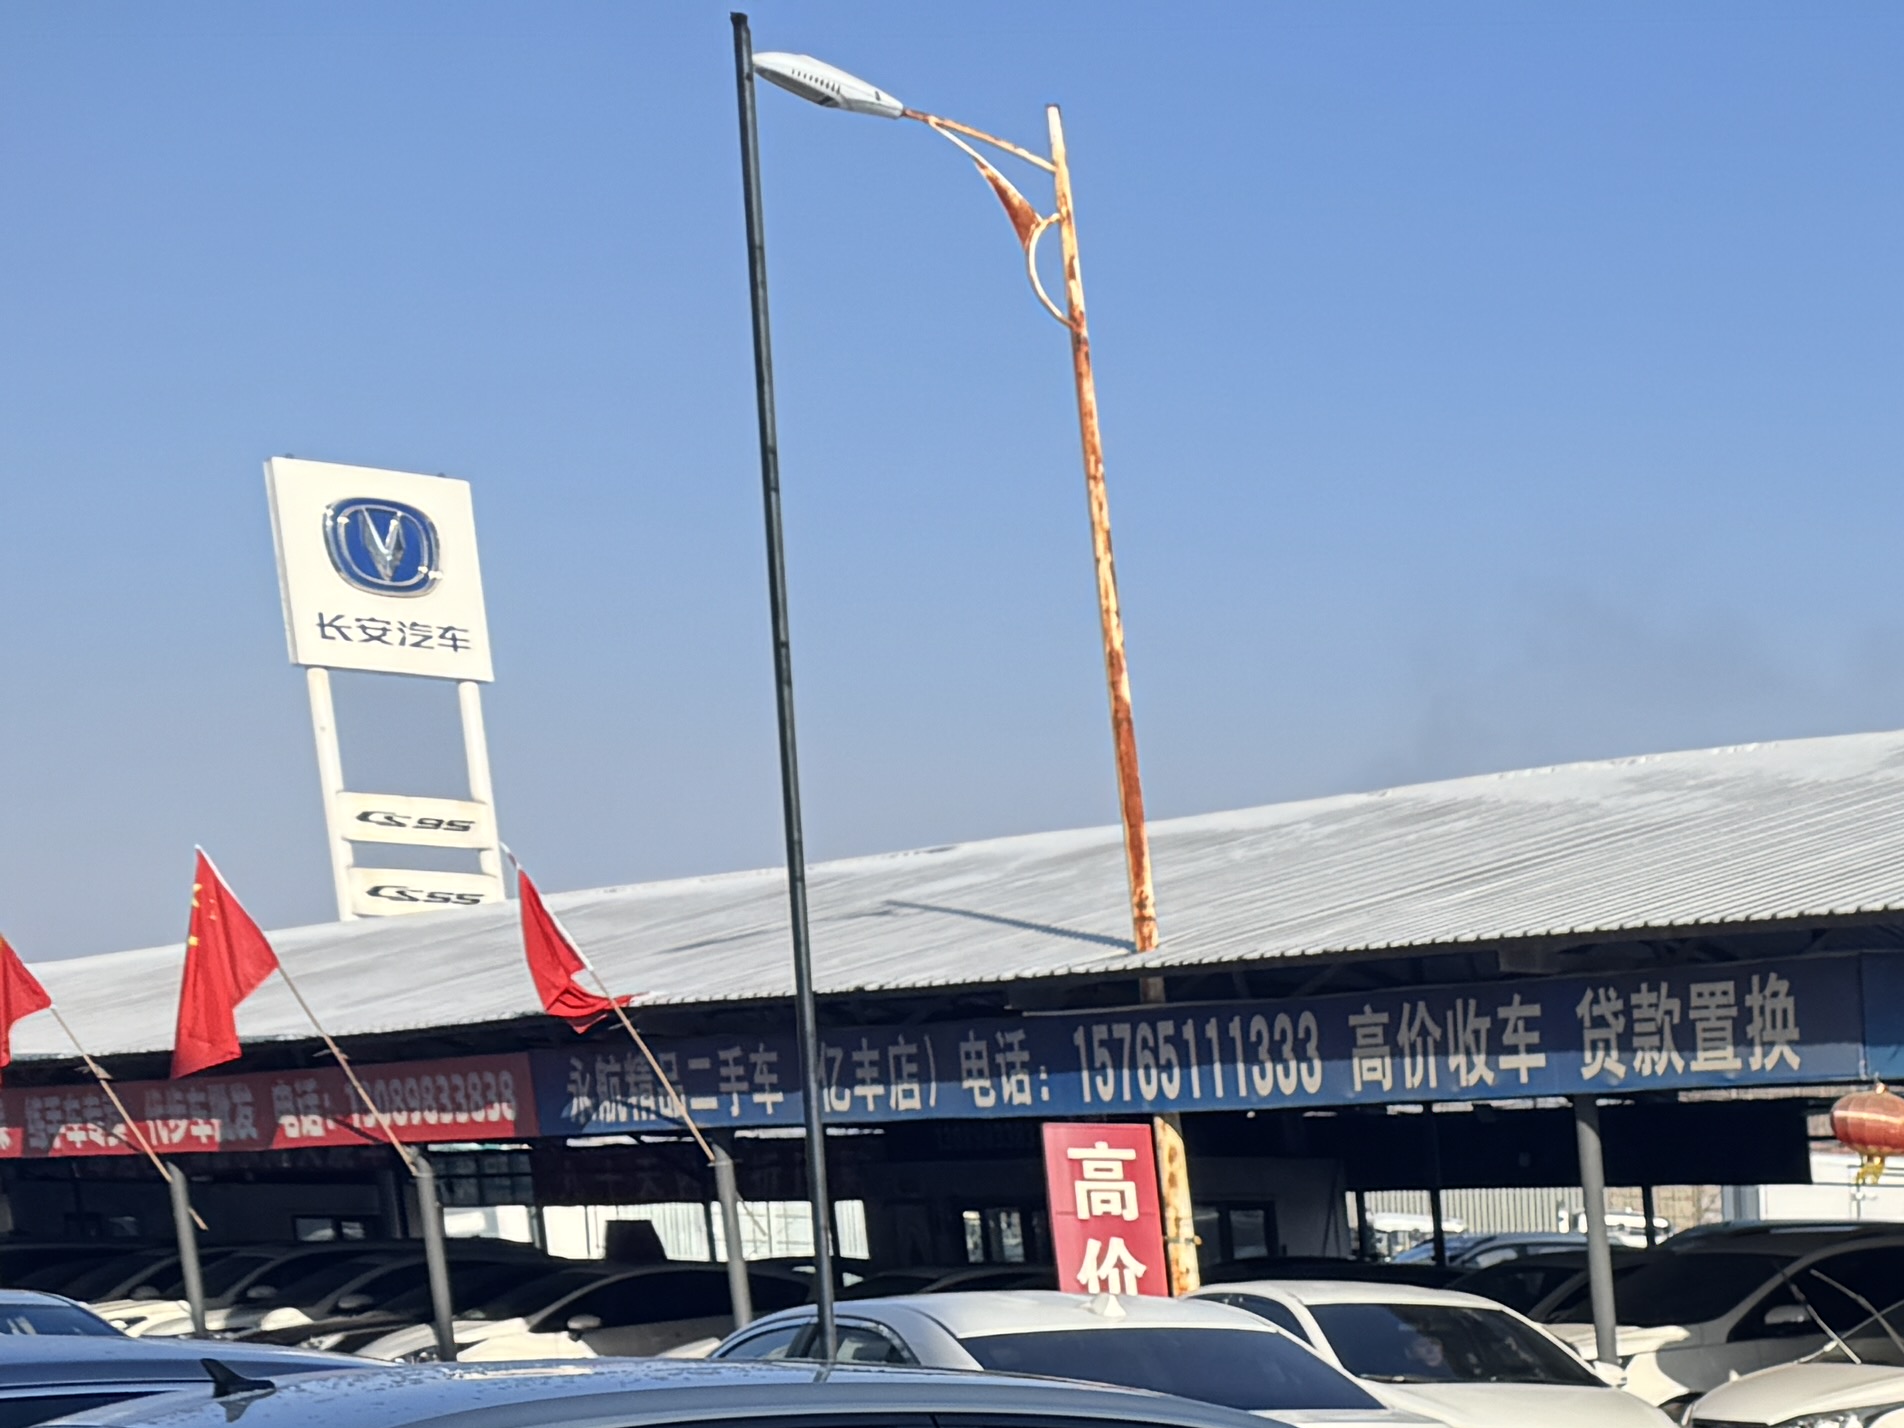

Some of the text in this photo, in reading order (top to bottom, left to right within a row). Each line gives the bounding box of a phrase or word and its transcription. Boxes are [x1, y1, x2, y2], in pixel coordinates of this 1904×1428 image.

[316, 611, 472, 654] 长安汽车
[1073, 1009, 1323, 1103] 15765111333
[1347, 993, 1548, 1093] 高价收车
[1576, 972, 1801, 1082] 贷款置换
[1066, 1141, 1148, 1296] 高价
